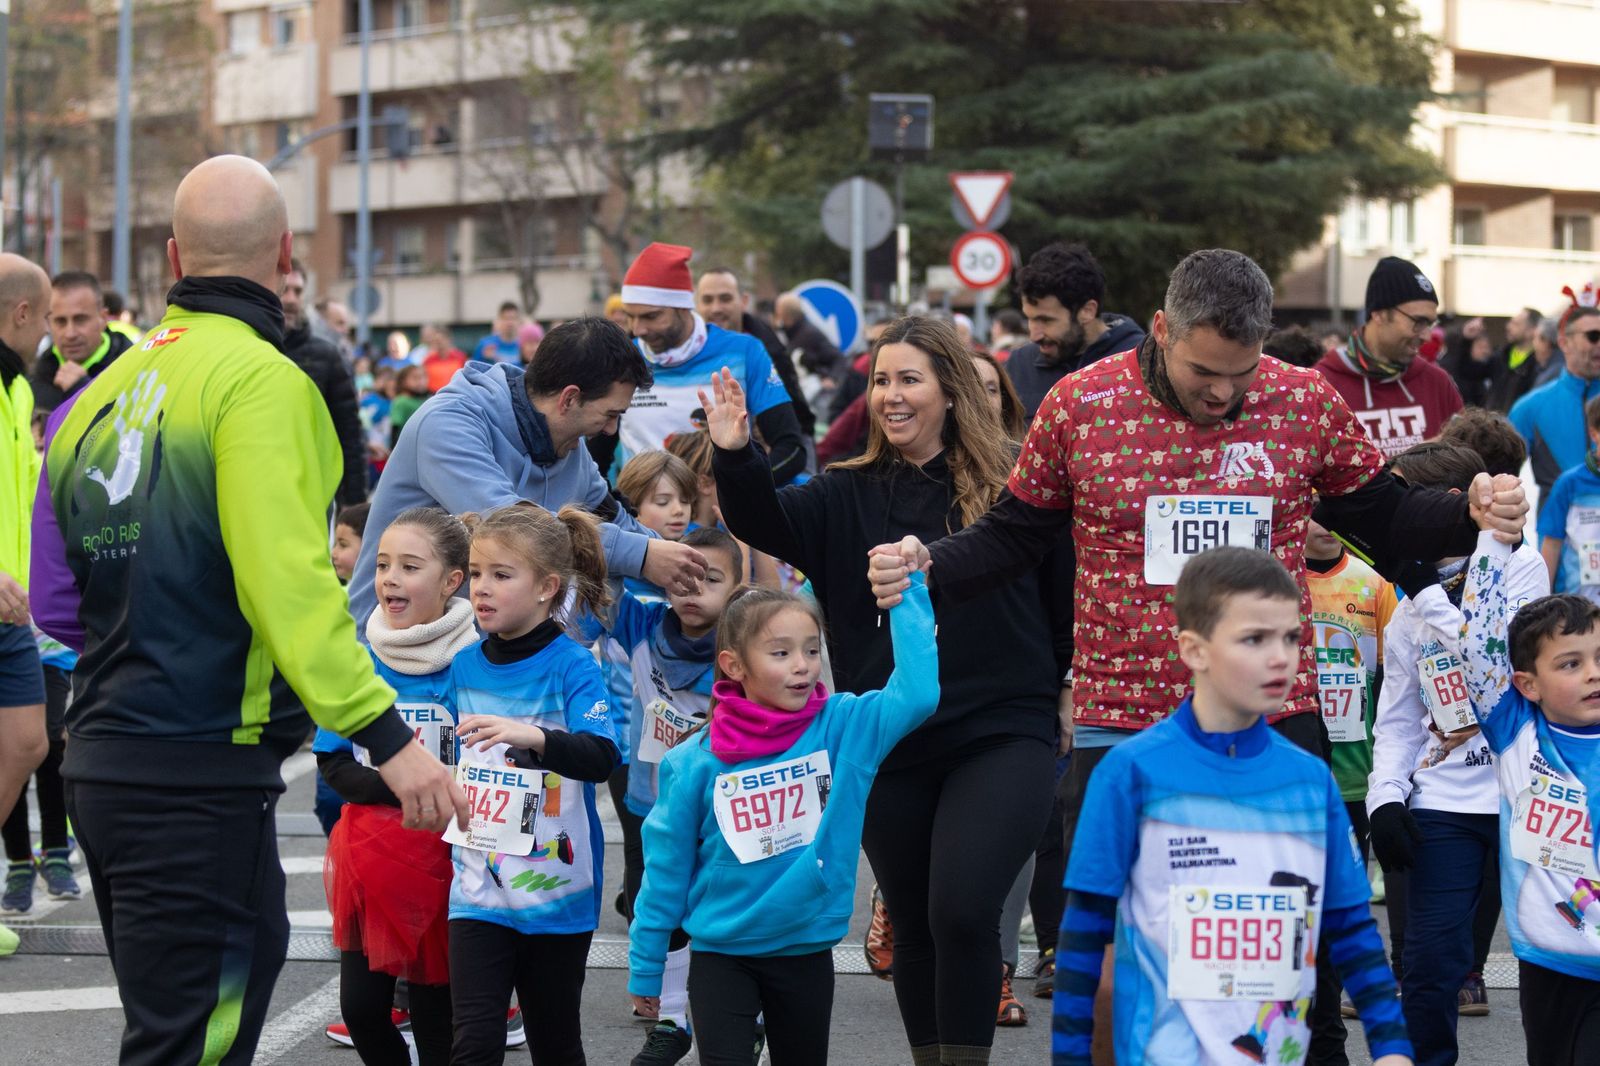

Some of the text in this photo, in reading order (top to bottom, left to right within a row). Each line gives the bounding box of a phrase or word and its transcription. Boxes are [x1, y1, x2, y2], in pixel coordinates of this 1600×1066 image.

[966, 253, 996, 270] 30
[1371, 434, 1423, 449] RANCISCO
[1179, 500, 1259, 516] SETEL
[1171, 519, 1230, 554] 1691
[1313, 612, 1362, 639] EPORTIVO
[1319, 673, 1361, 685] ETEL
[1433, 670, 1468, 707] 68
[1319, 688, 1353, 717] 57
[397, 708, 443, 723] TEL
[467, 767, 530, 788] SETEL
[742, 761, 818, 790] SETEL
[462, 783, 511, 824] 942
[729, 783, 807, 833] 6972
[1169, 846, 1220, 858] SILVESTRE
[1170, 858, 1238, 870] SALMANTINA
[1213, 893, 1296, 912] SETEL
[1191, 917, 1283, 961] 6693
